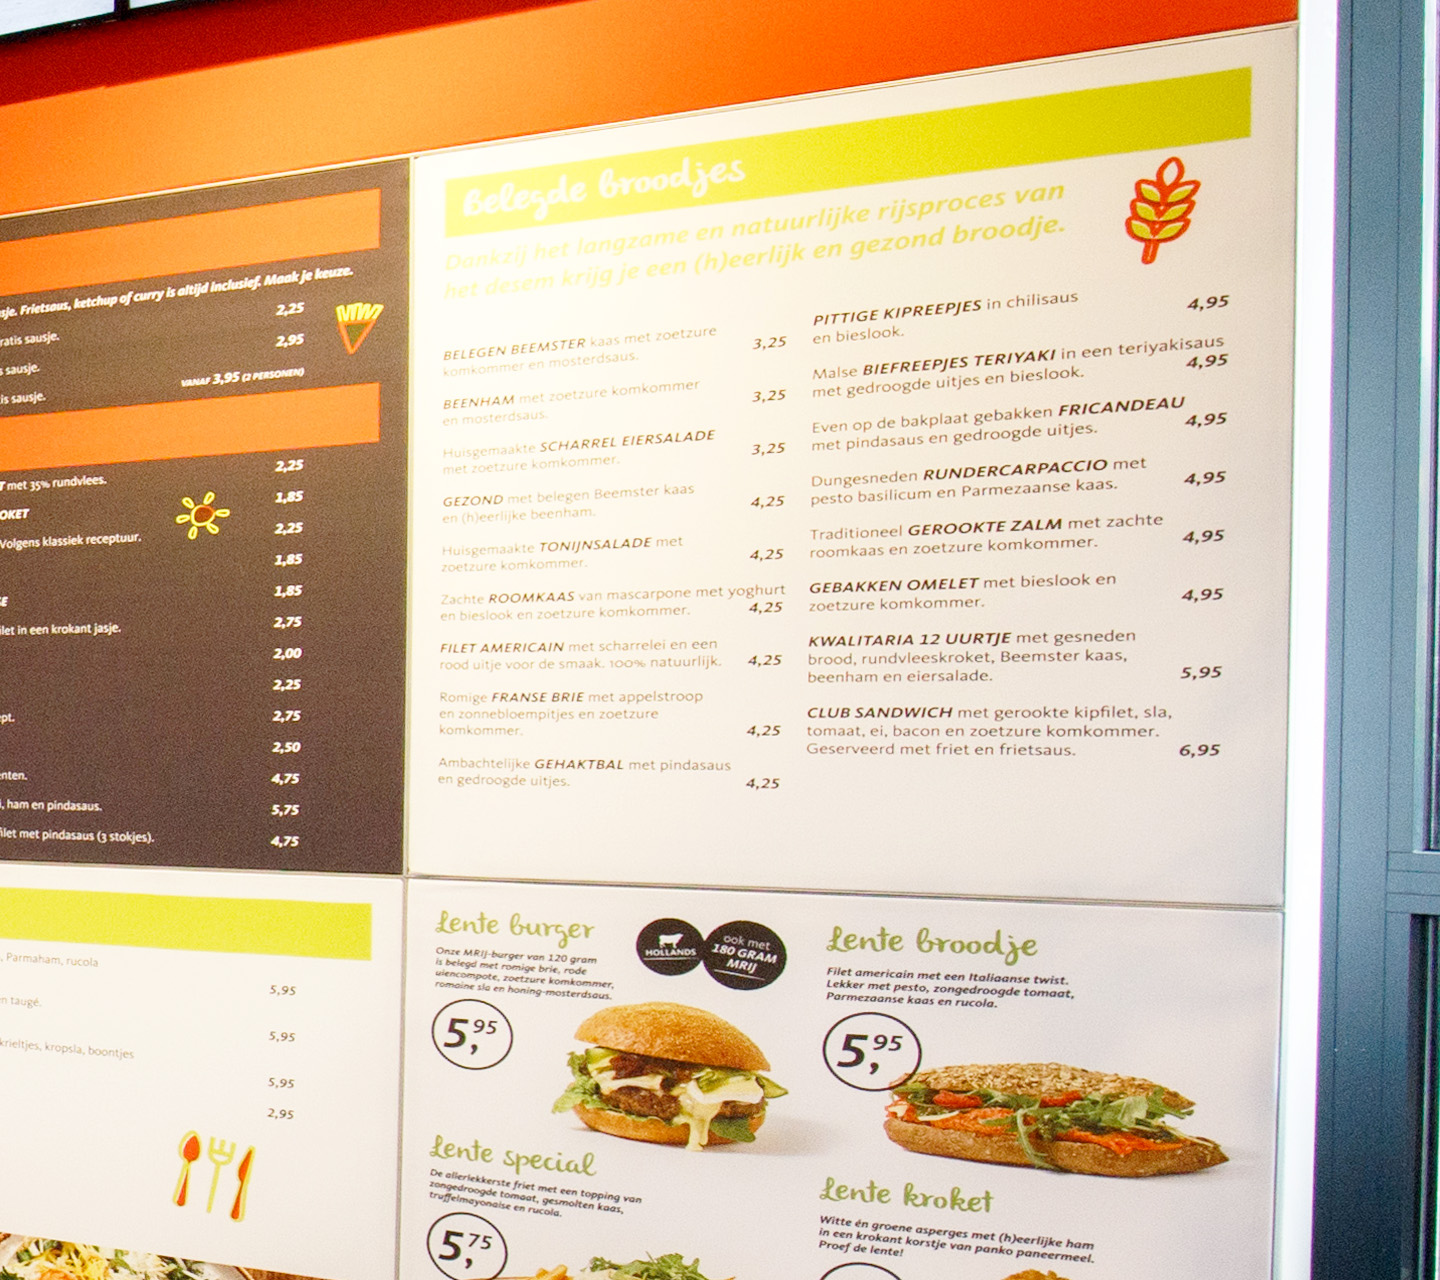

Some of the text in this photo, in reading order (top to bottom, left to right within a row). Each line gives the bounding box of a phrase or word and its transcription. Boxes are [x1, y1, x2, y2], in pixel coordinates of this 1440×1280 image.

[462, 158, 746, 220] Belegde broodjes
[276, 302, 304, 317] 2,25
[813, 291, 1078, 327] PITTIGE KIPREEPJES in chilisaus
[1187, 295, 1229, 314] 4,95
[276, 333, 304, 348] 2,95
[808, 630, 1136, 648] KWALITARIA 12 UURTJE met gesneden
[1180, 665, 1222, 681] 5,95
[807, 706, 1172, 722] CLUB SANDWICH met gerookte kipfilet, sla,
[1179, 743, 1220, 759] 6,95
[435, 910, 595, 948] Lente burger
[723, 934, 771, 950] ook met
[826, 926, 1038, 966] Lente broodje
[645, 947, 697, 957] HOLLANDS
[711, 943, 777, 964] 180 GRAM
[726, 958, 757, 974] MRIJ
[430, 1135, 597, 1177] Lente special
[819, 1177, 994, 1214] Lente kroket
